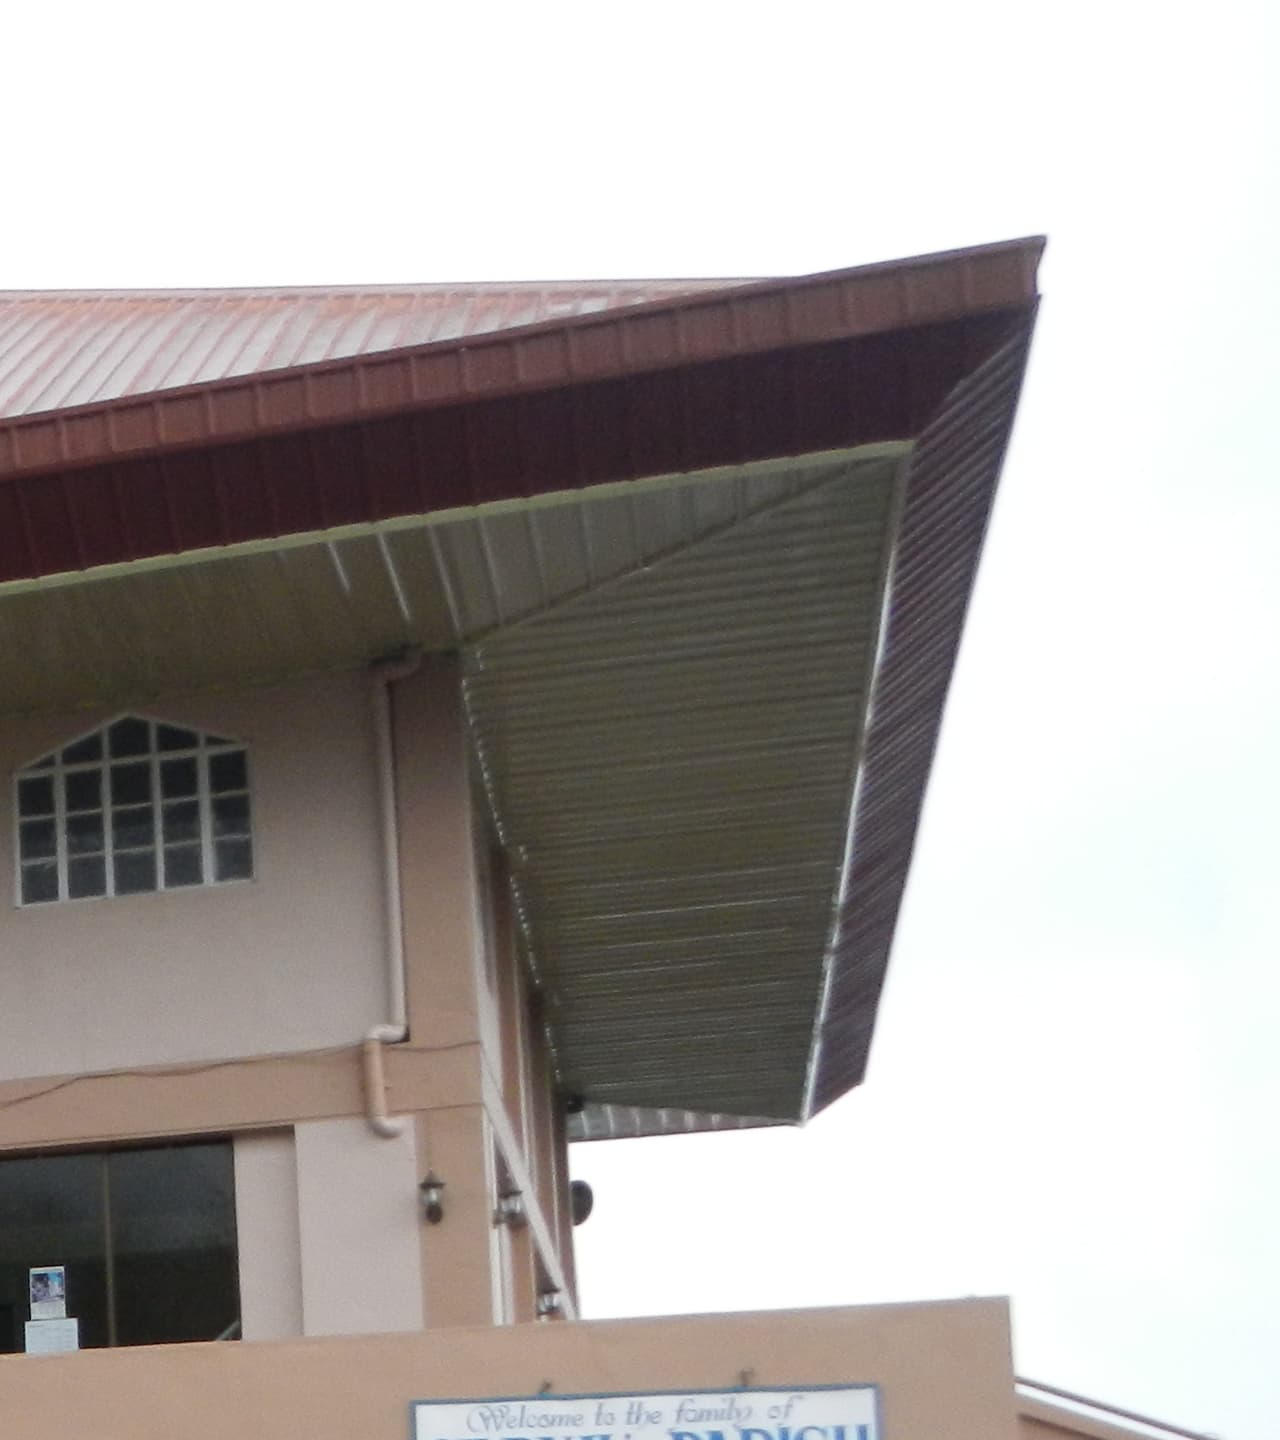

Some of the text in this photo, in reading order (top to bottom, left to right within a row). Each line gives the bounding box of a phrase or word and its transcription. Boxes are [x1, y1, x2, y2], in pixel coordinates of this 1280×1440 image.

[467, 1394, 804, 1433] Welcome to the family of
